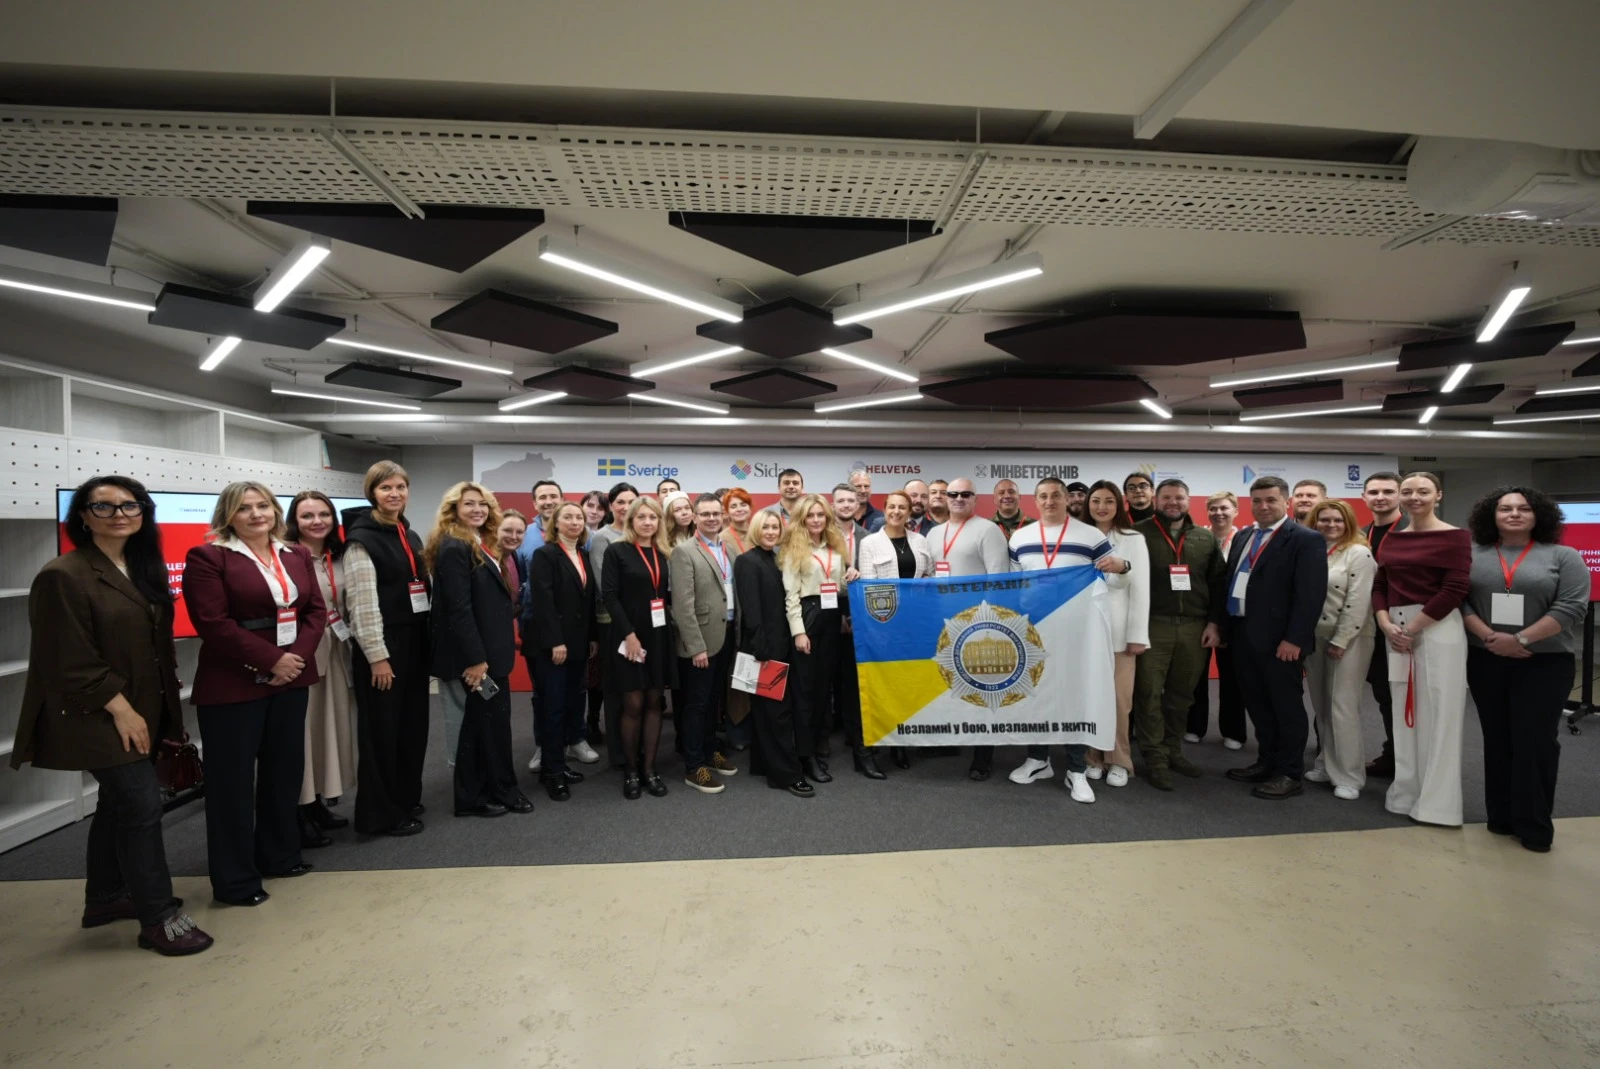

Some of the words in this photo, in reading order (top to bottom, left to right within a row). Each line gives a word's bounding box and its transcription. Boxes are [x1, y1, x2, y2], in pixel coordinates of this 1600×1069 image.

[628, 464, 679, 479] Sverige
[866, 465, 921, 474] HELVETAS
[990, 464, 1079, 479] МІНВЕТЕРАНІВ
[897, 722, 951, 735] Незламні
[953, 724, 960, 735] у
[962, 721, 989, 735] бою,
[991, 720, 1050, 734] незламні
[1052, 723, 1059, 732] в
